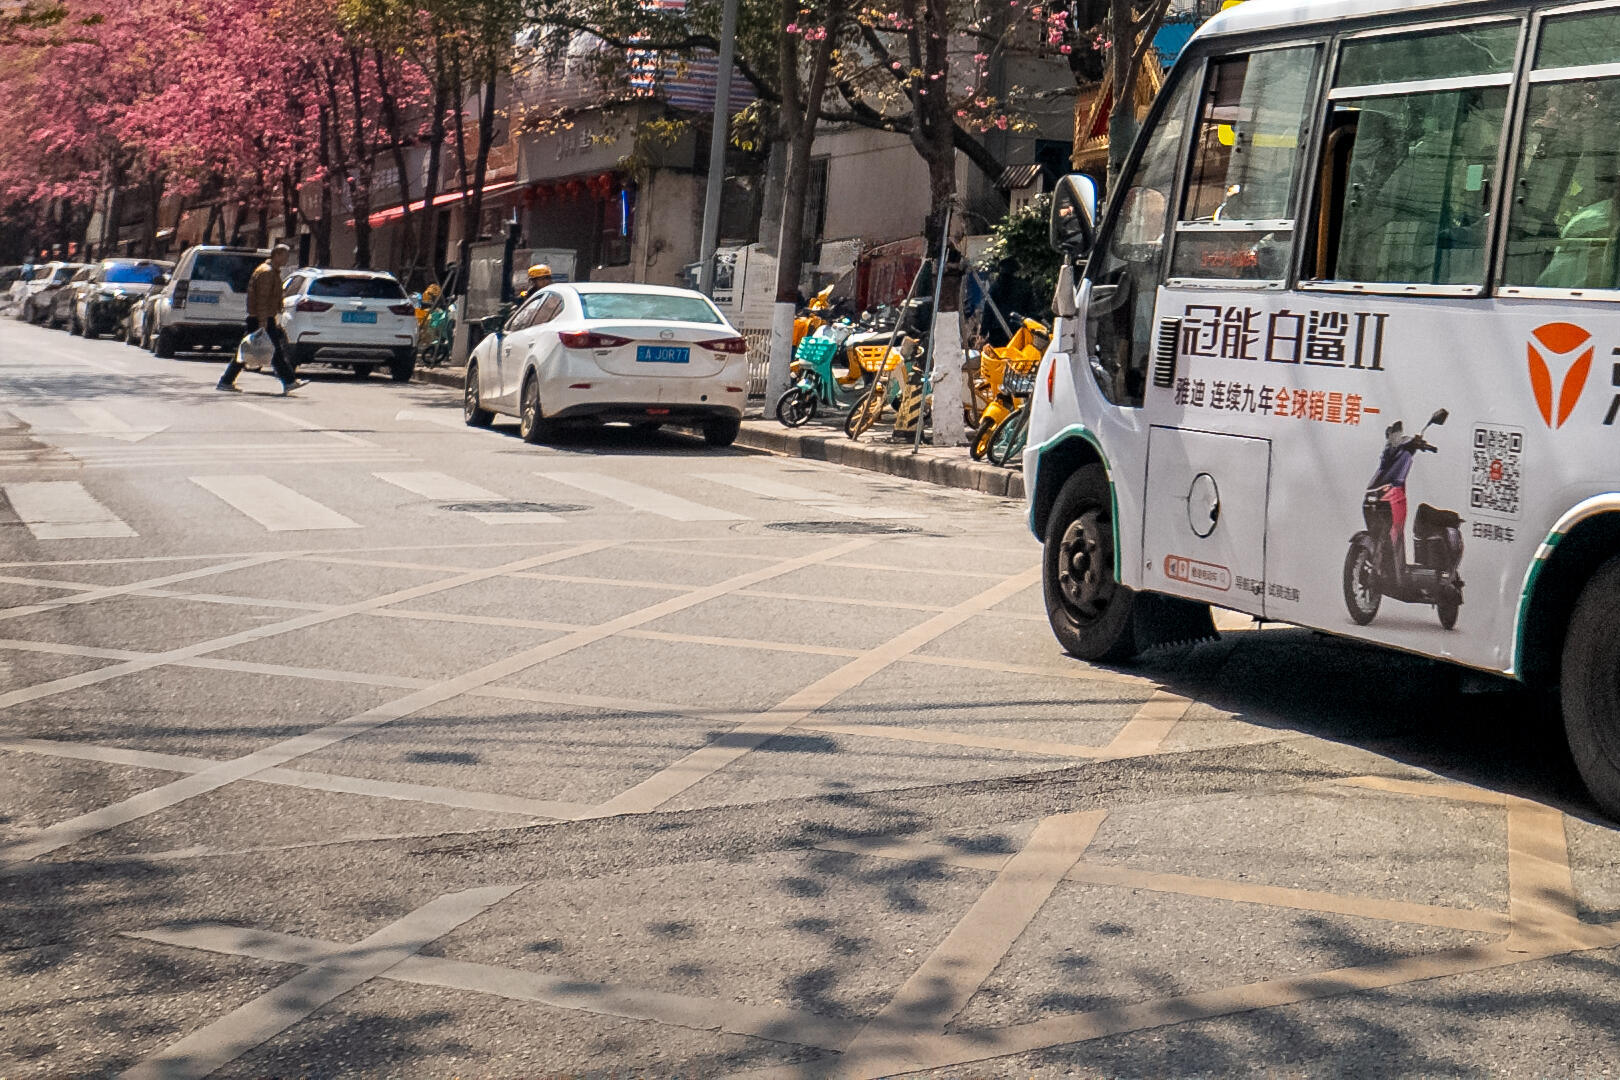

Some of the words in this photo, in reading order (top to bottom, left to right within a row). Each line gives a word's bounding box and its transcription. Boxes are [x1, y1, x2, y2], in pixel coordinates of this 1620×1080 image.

[1174, 376, 1206, 408] 雅迪
[1209, 379, 1381, 425] 连续九年全球销量第一
